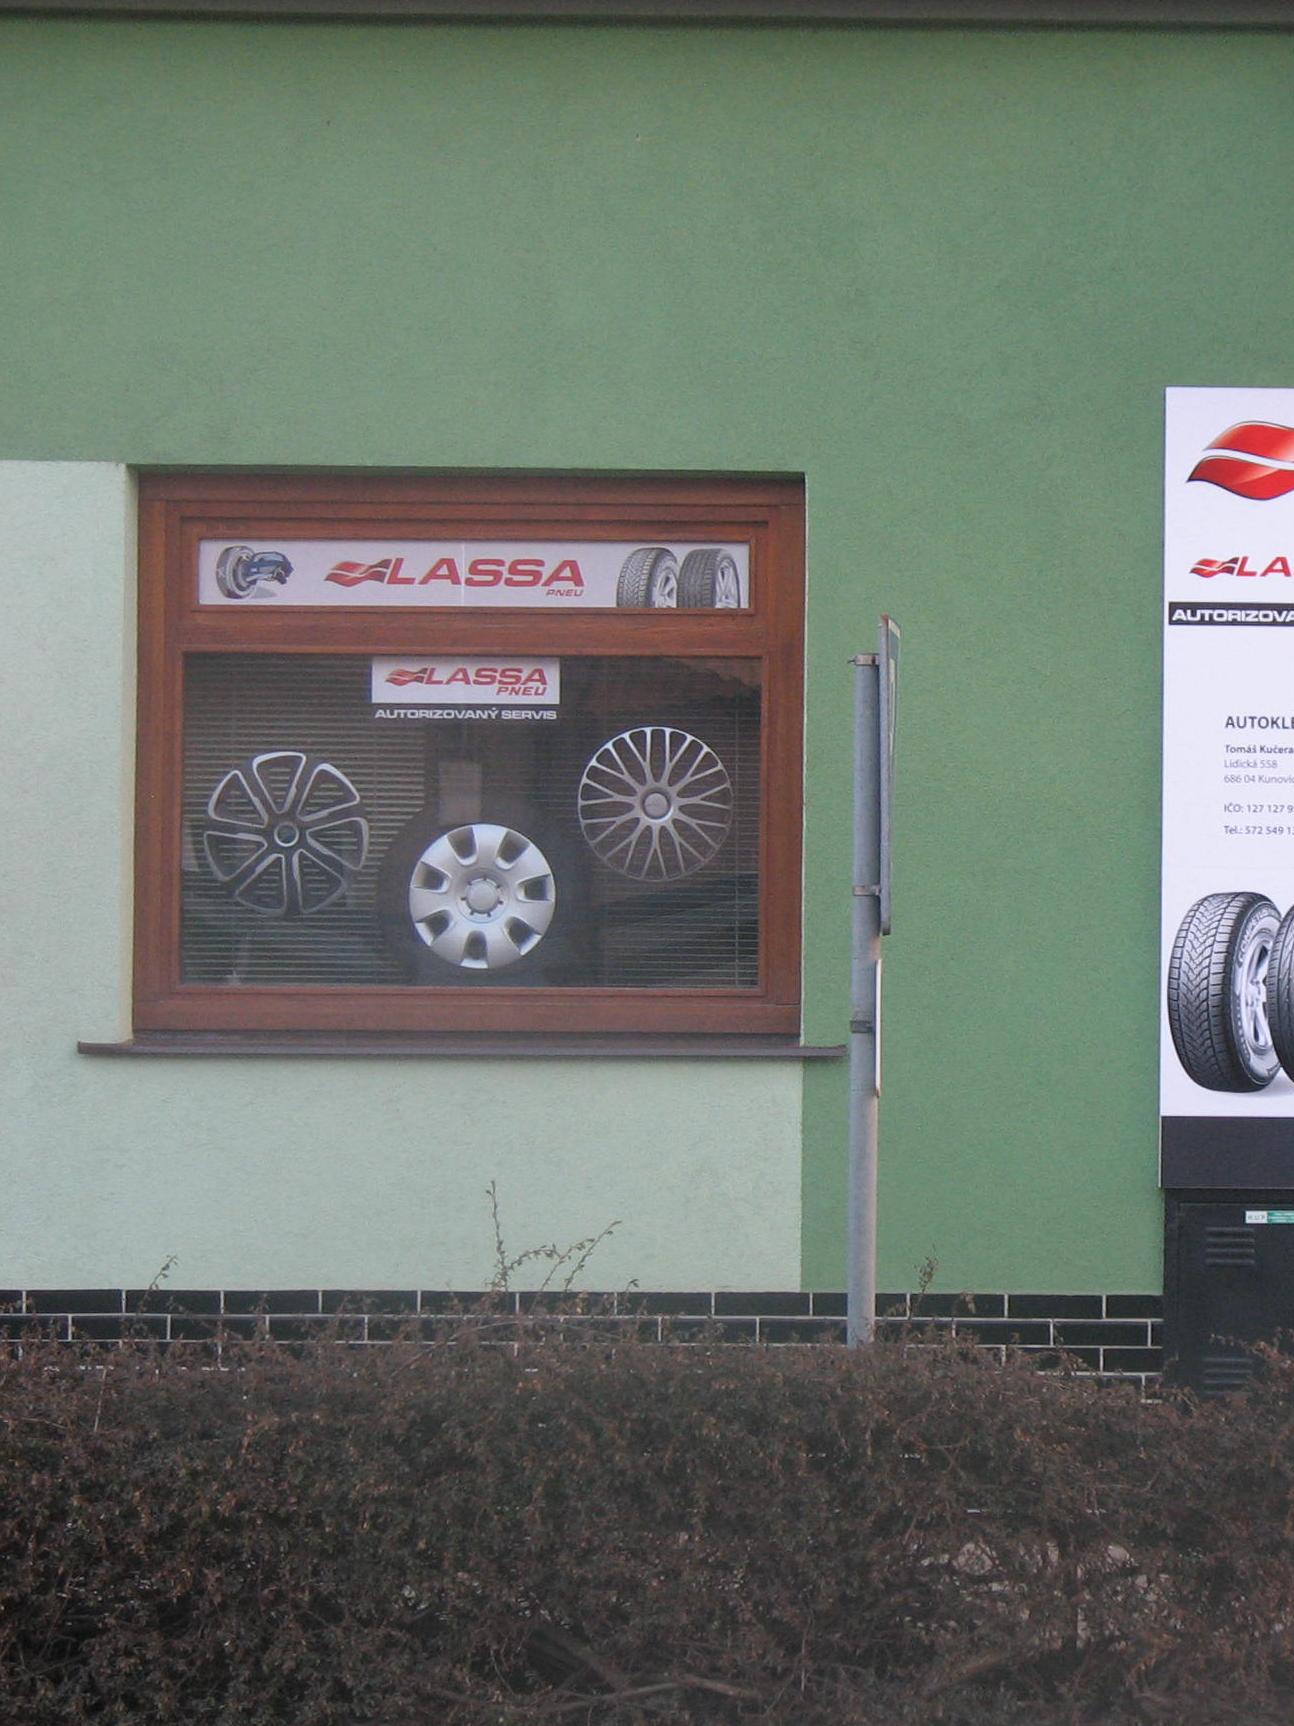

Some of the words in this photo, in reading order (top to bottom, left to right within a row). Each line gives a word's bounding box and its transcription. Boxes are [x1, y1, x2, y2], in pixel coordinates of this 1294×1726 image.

[387, 557, 586, 588] LASSA
[545, 588, 584, 598] PNEU
[424, 667, 548, 686] LASSA
[495, 686, 547, 697] PNEU
[374, 706, 499, 720] AUTORIZOVANÝ
[501, 709, 557, 721] SERVIS
[1225, 744, 1257, 754] Tomáš
[1259, 745, 1294, 755] Kučera
[1224, 759, 1258, 769] Lidická
[1223, 774, 1241, 784] 686
[1243, 775, 1256, 784] 04
[1224, 802, 1244, 813] IČO:
[1247, 804, 1264, 814] 127
[1268, 804, 1285, 814] 127
[1245, 826, 1263, 835] 572
[1265, 826, 1284, 836] 549
